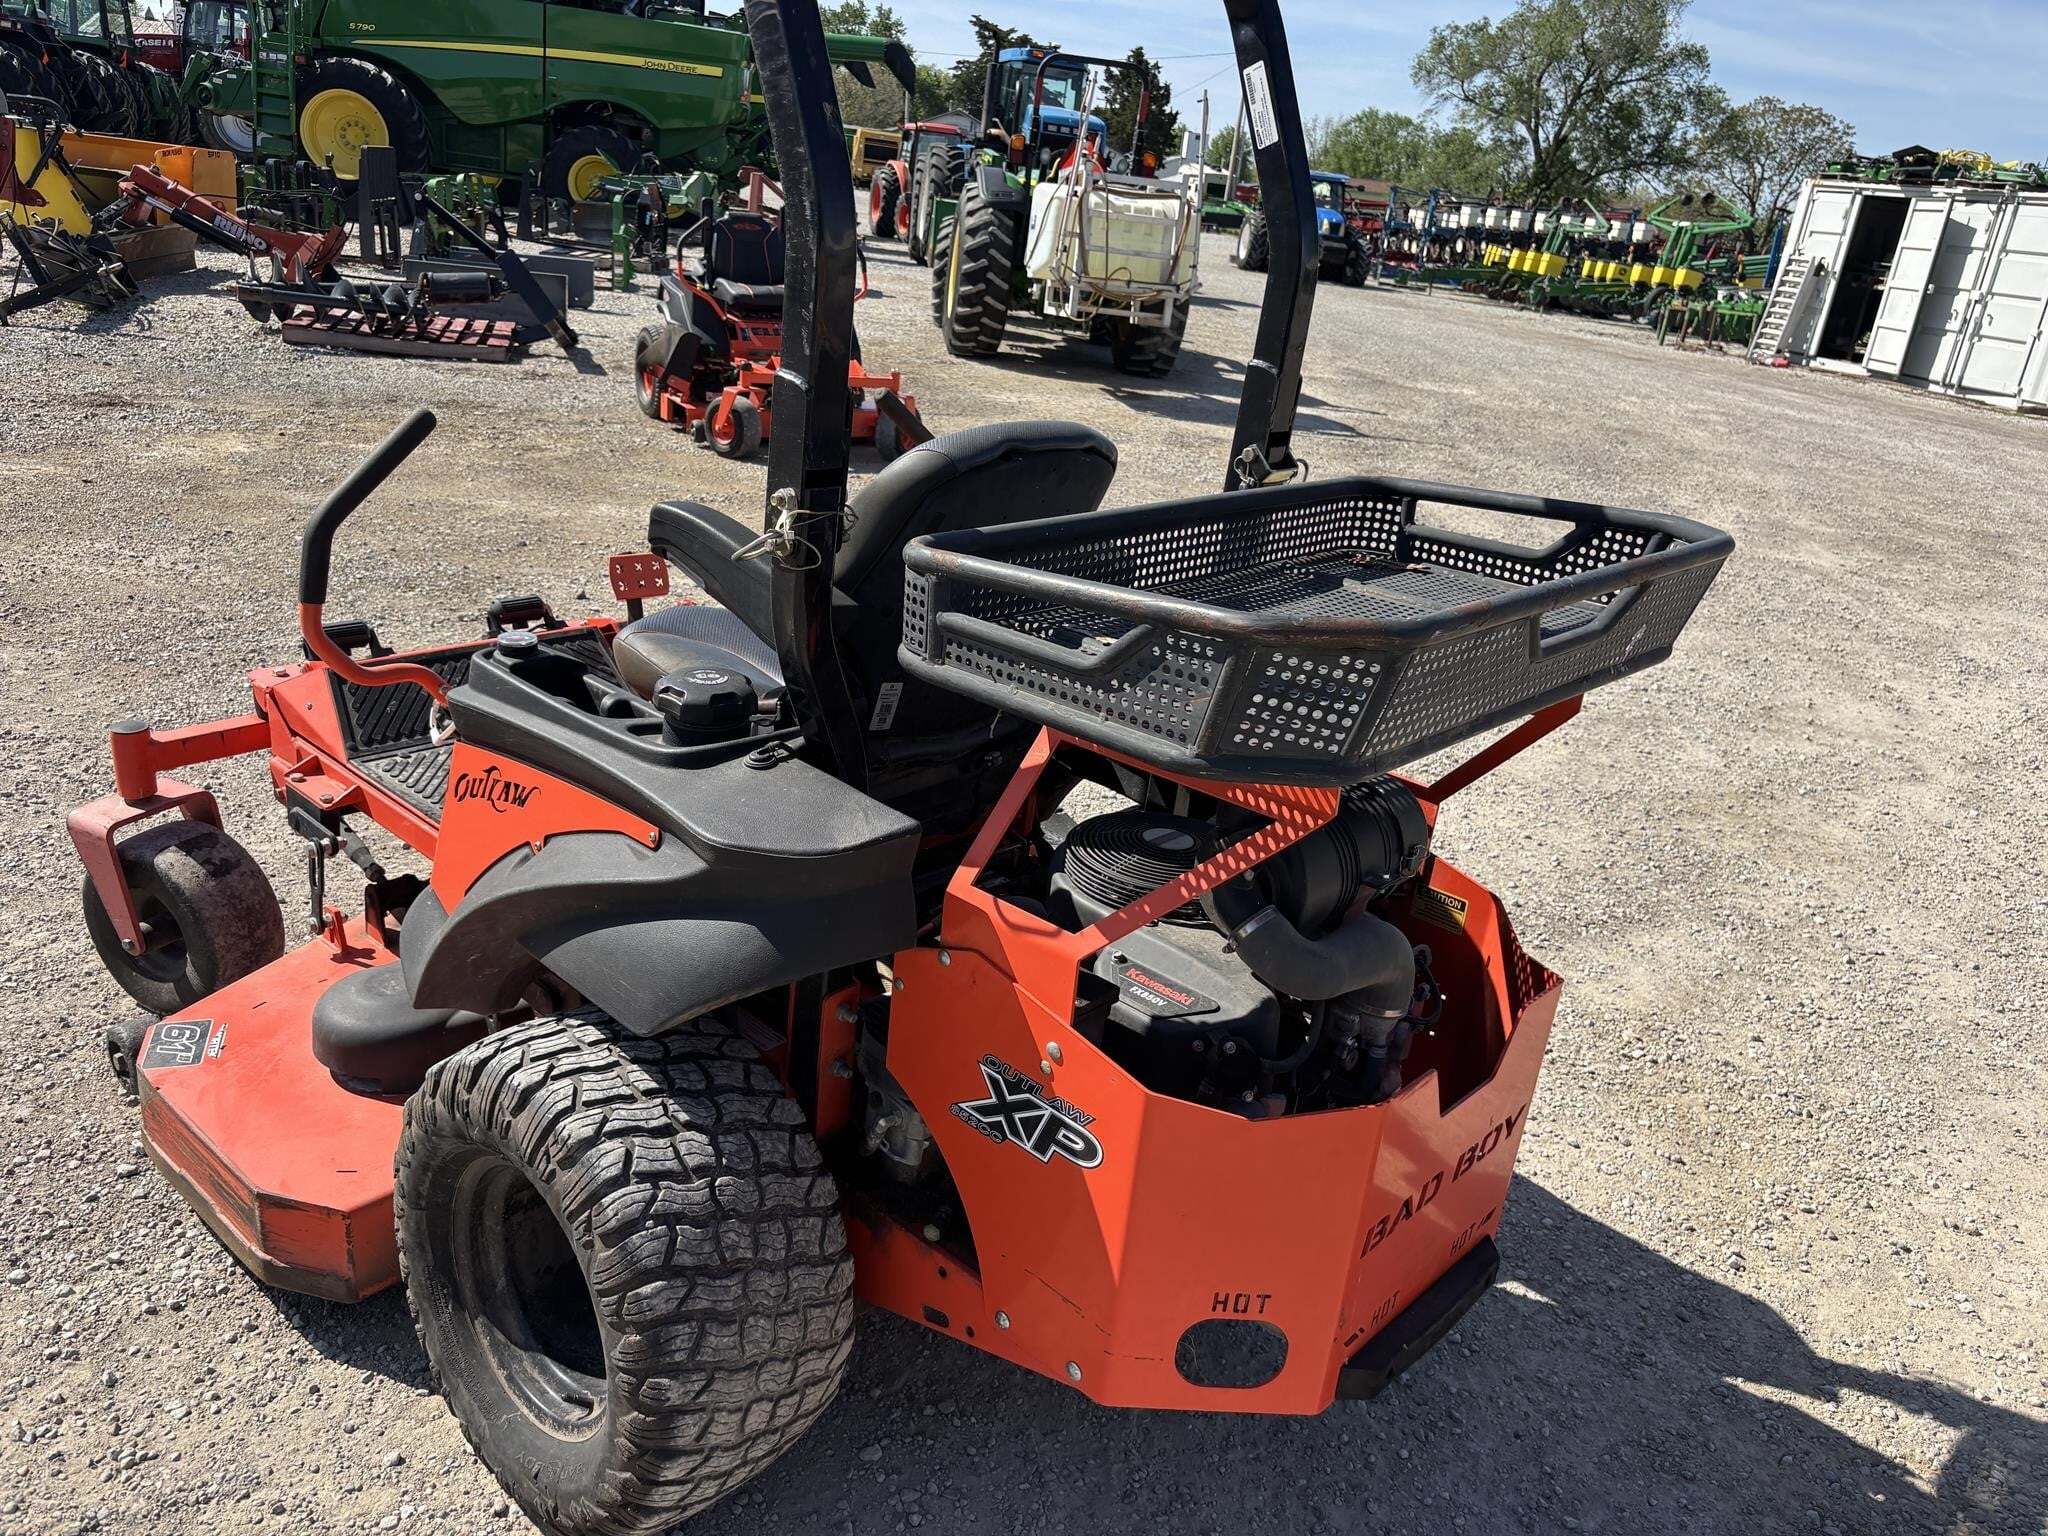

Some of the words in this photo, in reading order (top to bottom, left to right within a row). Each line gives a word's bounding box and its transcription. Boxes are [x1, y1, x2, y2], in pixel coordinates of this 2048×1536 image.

[134, 38, 161, 48] CASE
[349, 22, 376, 31] S790
[642, 59, 667, 70] JOHN
[668, 62, 698, 74] DEERE
[213, 214, 267, 250] RHINO
[1126, 967, 1195, 1006] Kawasaki
[982, 1053, 1097, 1127] OUTLAW
[957, 1061, 1105, 1170] XP
[1359, 1170, 1445, 1260] BAD
[1451, 1103, 1527, 1184] BOY
[1450, 1221, 1477, 1257] HOT
[1210, 1291, 1273, 1314] HOT
[1370, 1289, 1401, 1329] HOT
